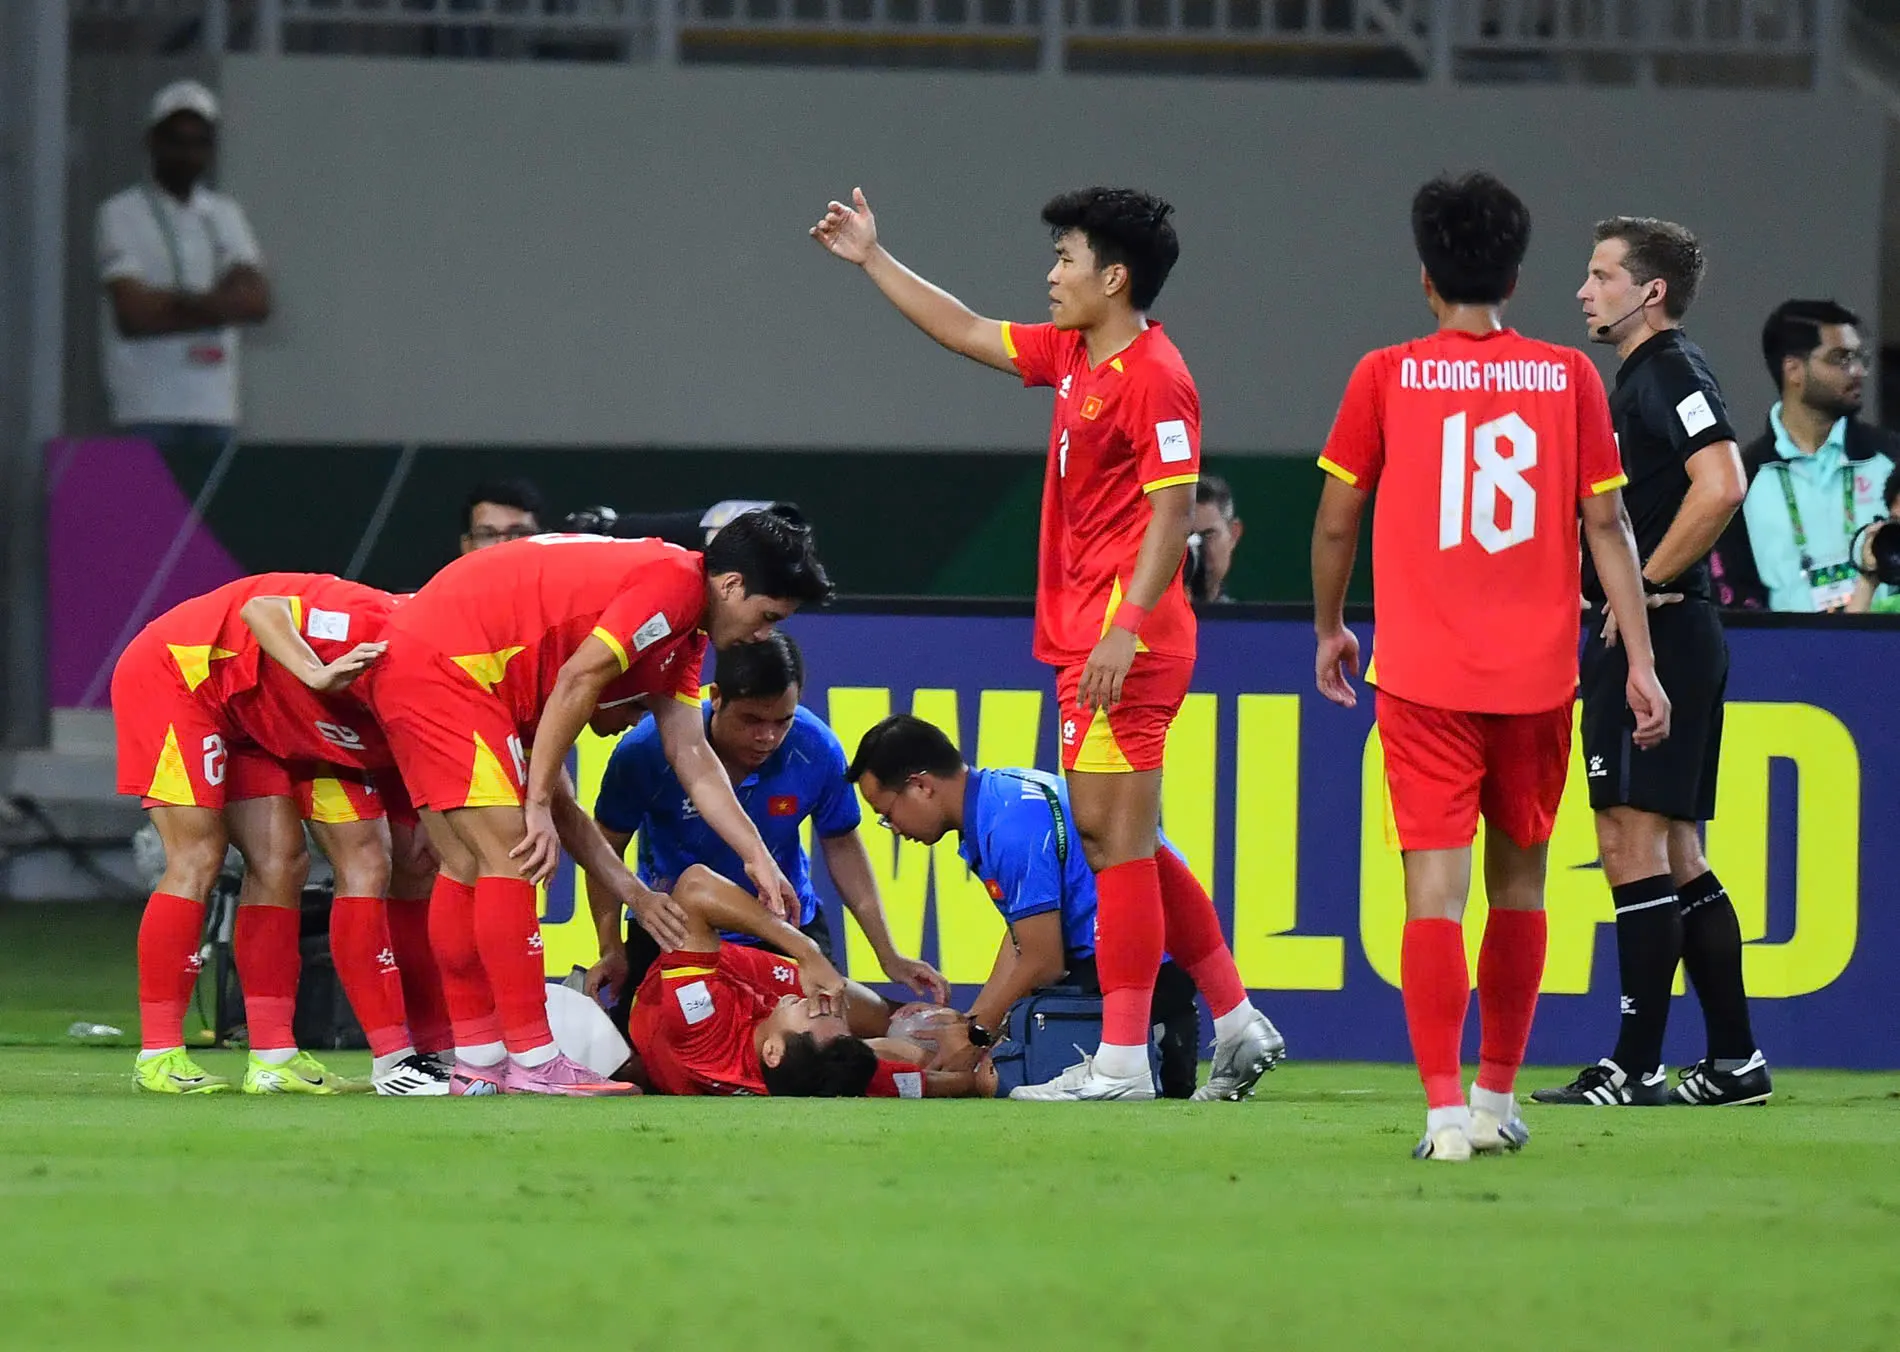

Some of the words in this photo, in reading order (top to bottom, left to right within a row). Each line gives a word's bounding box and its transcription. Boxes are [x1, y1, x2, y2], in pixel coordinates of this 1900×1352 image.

[1401, 358, 1480, 391] N.CONG
[1483, 366, 1567, 392] PHUONG
[1439, 411, 1537, 555] 18
[540, 687, 1861, 999] DWLAD
[1055, 821, 1066, 847] ASIAN
